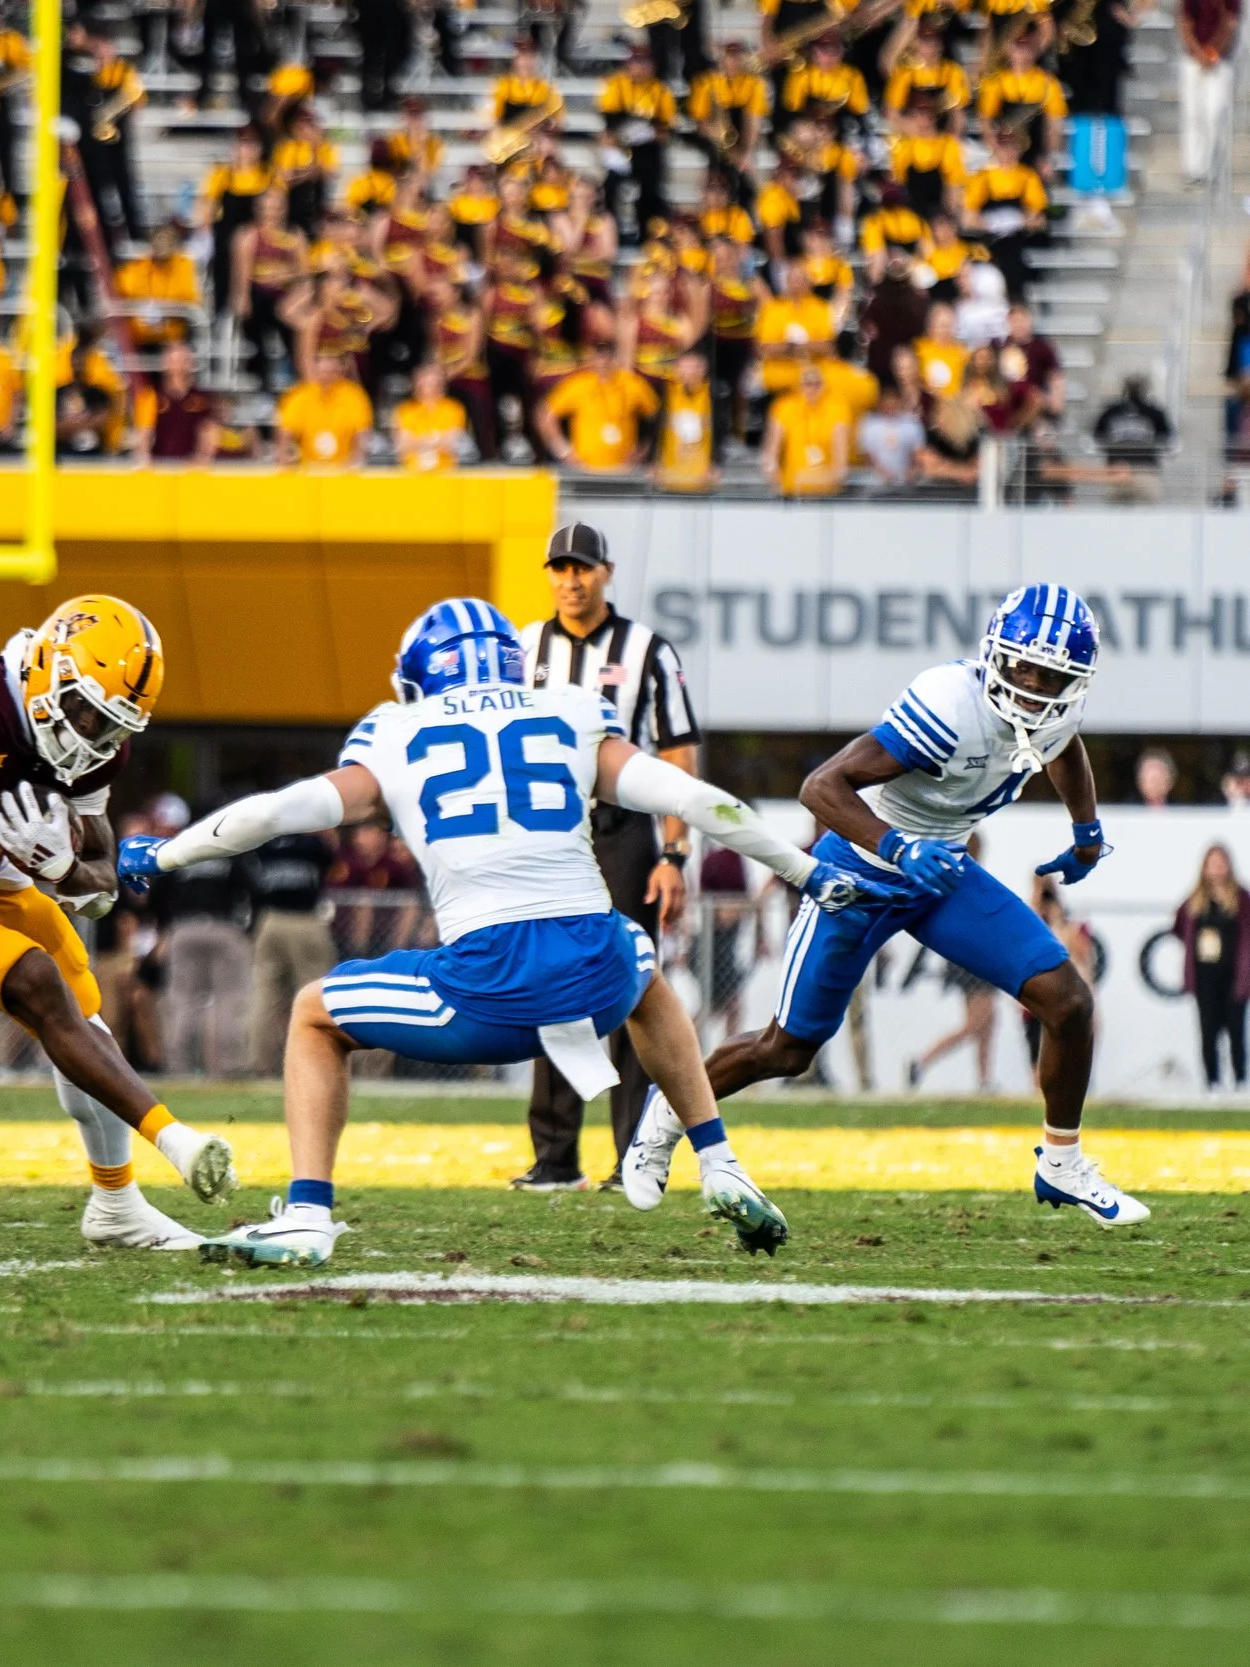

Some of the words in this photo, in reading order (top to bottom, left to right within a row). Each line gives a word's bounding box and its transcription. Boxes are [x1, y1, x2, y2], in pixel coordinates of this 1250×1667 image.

[651, 585, 1002, 655] STUDEN
[443, 690, 535, 716] SLADE
[405, 715, 584, 846] 26
